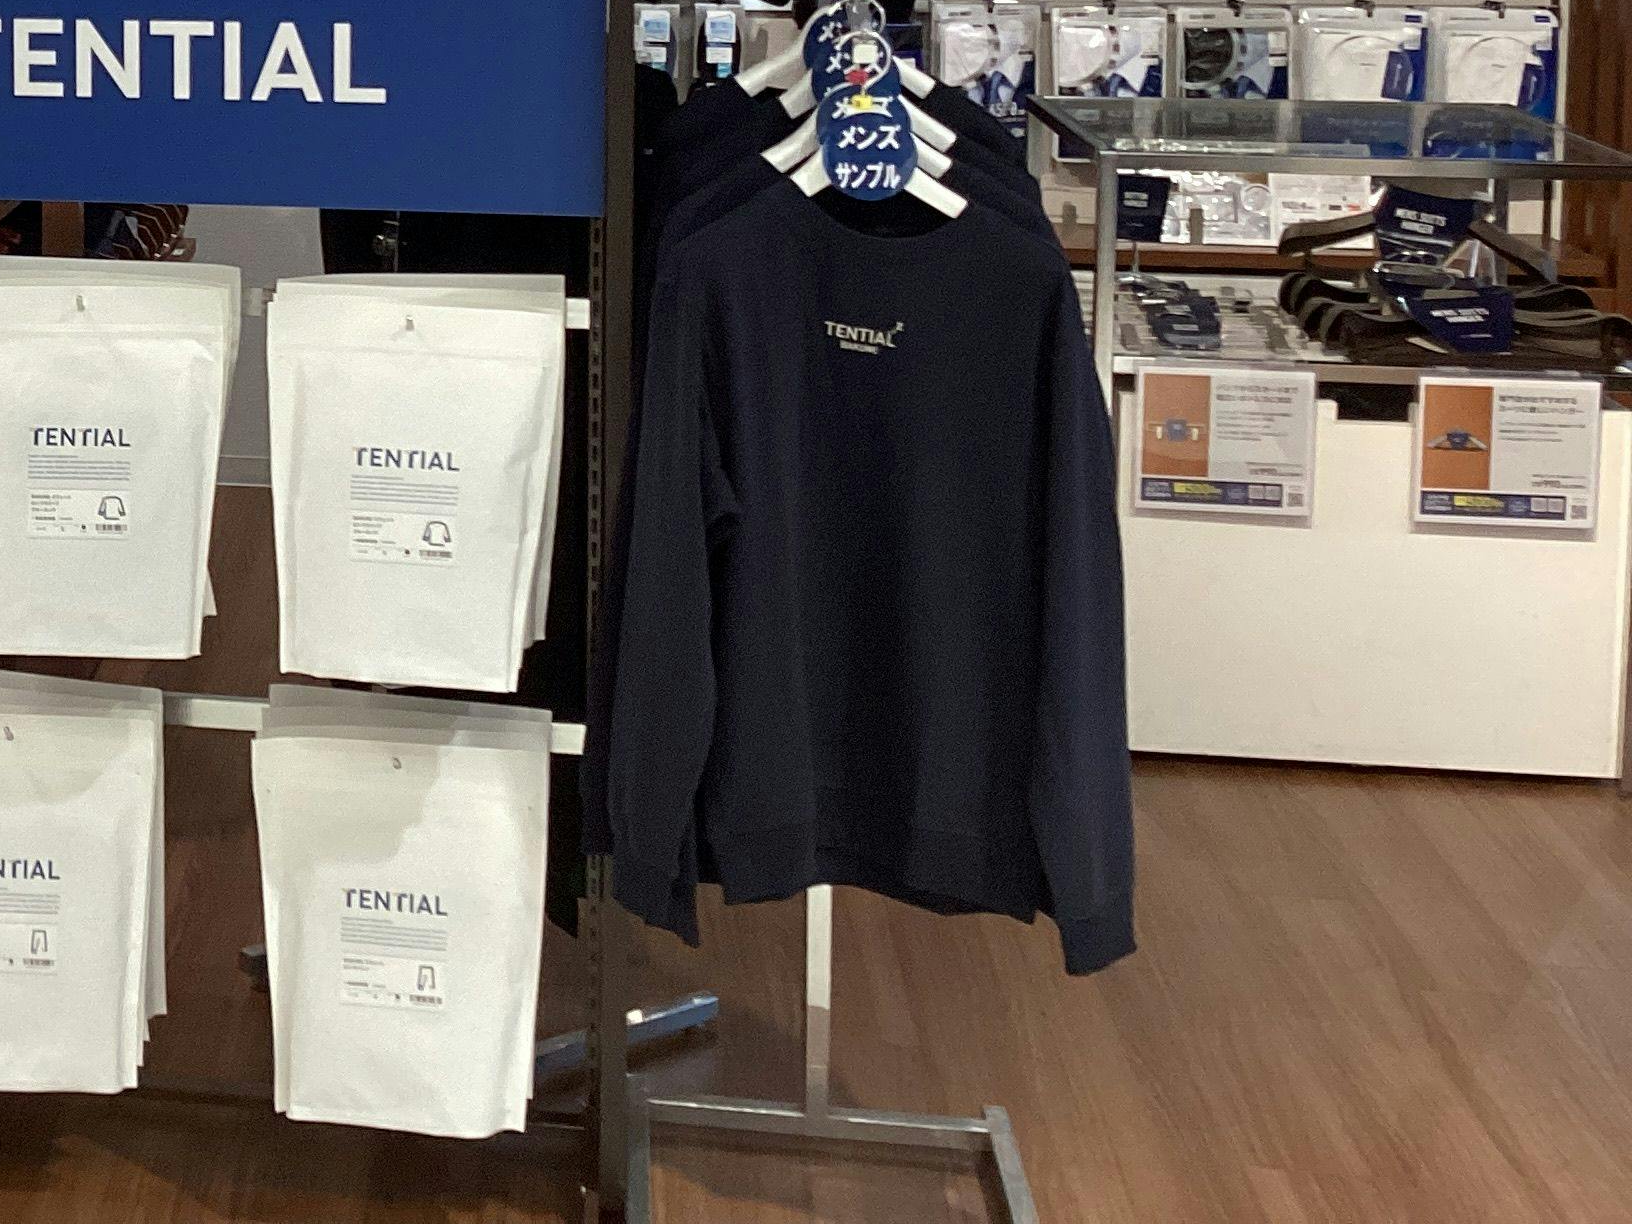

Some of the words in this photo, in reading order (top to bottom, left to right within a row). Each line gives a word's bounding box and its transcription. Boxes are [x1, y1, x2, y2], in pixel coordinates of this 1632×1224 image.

[838, 125, 901, 150] メンズ
[835, 161, 901, 189] サンプル
[824, 321, 897, 348] TENTIAL
[30, 427, 131, 447] TENTIAL
[353, 447, 460, 471] TENTIAL
[342, 887, 448, 916] TENTIAL
